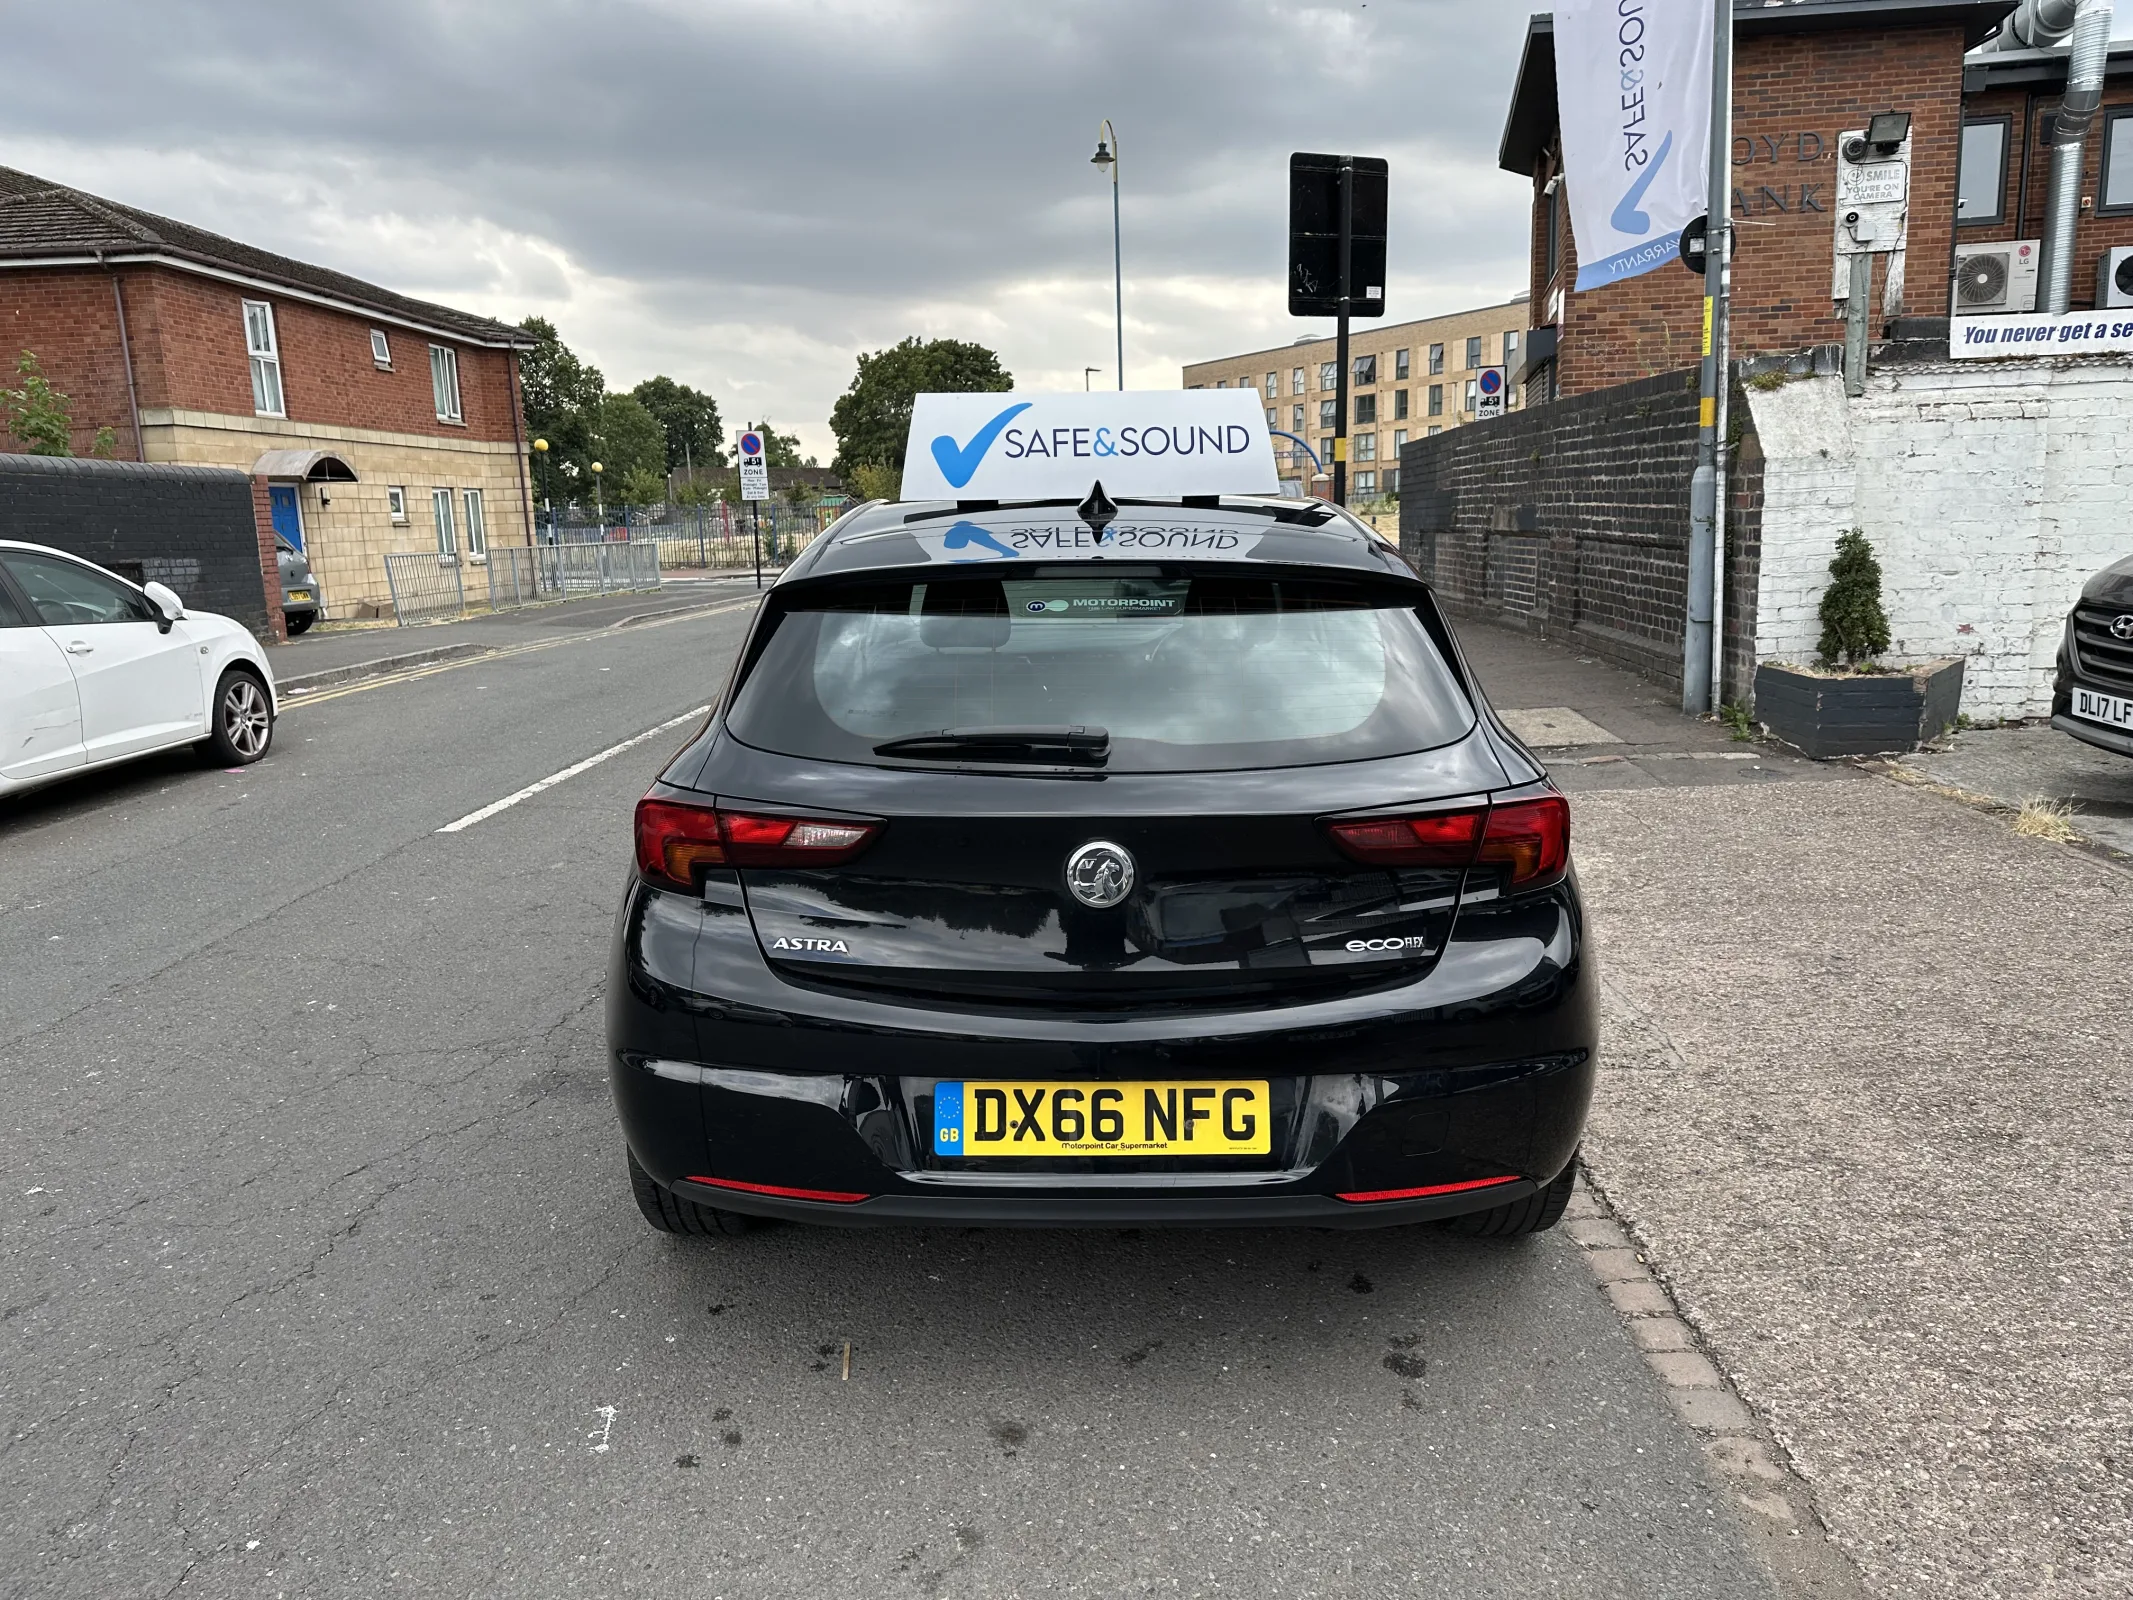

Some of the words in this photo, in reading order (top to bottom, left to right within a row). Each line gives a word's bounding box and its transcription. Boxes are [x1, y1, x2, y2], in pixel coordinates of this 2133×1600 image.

[1731, 131, 1824, 165] OYD
[1866, 169, 1901, 182] SMILE
[1846, 184, 1881, 194] YOU'RE
[1883, 183, 1900, 191] ON
[1853, 191, 1893, 201] CAMERA
[1731, 183, 1828, 216] ANK
[1965, 326, 1998, 344] You
[2000, 325, 2057, 343] never
[2057, 322, 2093, 343] get
[2094, 323, 2108, 339] a
[1005, 425, 1250, 459] SAFE&SOUND
[1073, 599, 1176, 607] MOTORPOINT
[772, 937, 848, 953] ASTRA
[974, 1088, 1124, 1141] DX66
[1144, 1088, 1256, 1141] NFG
[939, 1128, 960, 1143] GB
[1061, 1142, 1104, 1150] Motorpoint
